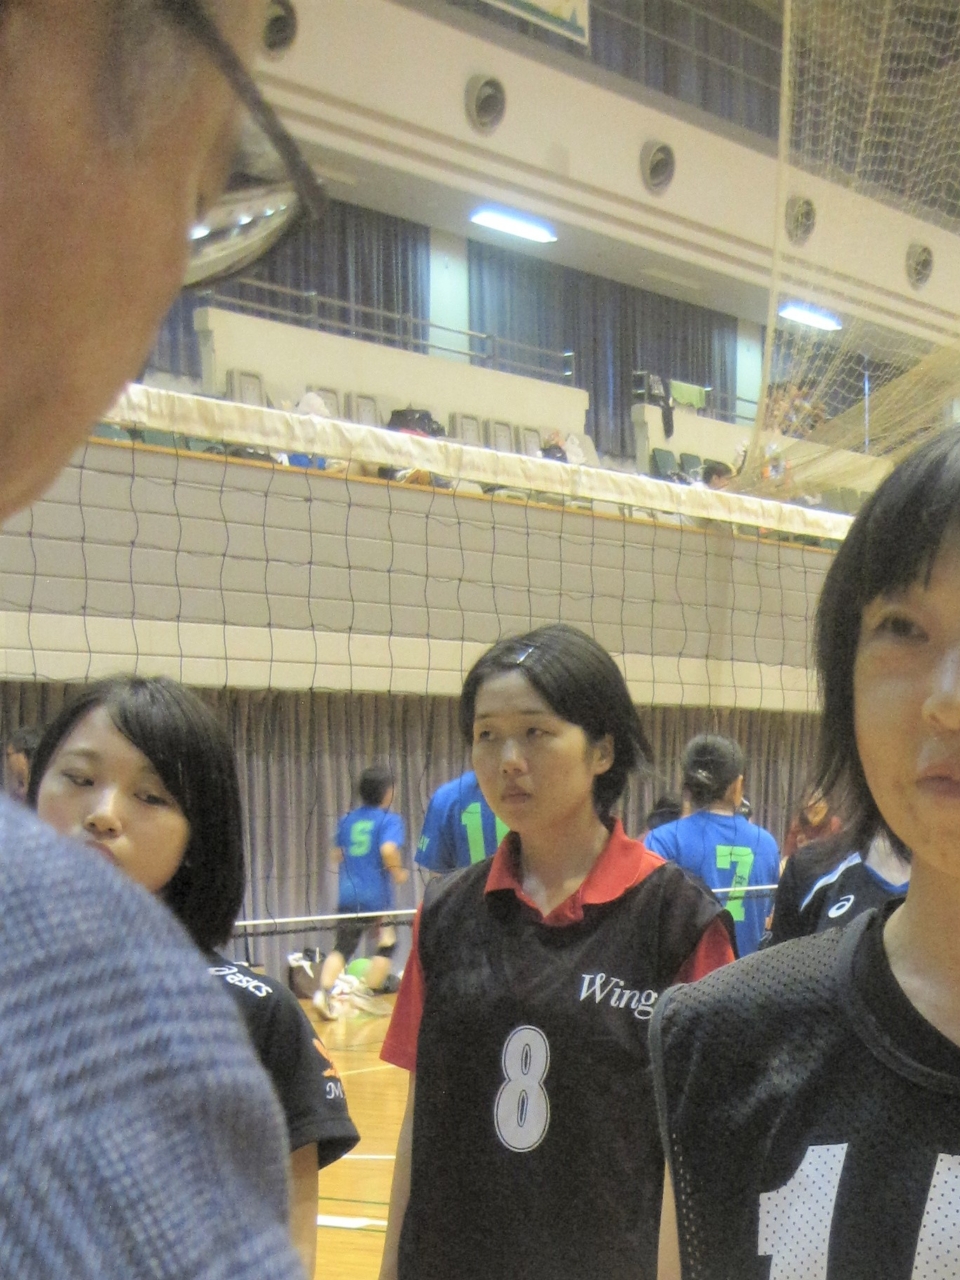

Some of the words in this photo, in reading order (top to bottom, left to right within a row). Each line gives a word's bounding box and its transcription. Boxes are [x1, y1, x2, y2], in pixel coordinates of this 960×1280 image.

[351, 820, 375, 856] 5
[461, 802, 510, 865] 1
[716, 845, 754, 921] 7
[226, 972, 273, 997] asics
[494, 1025, 550, 1152] 8
